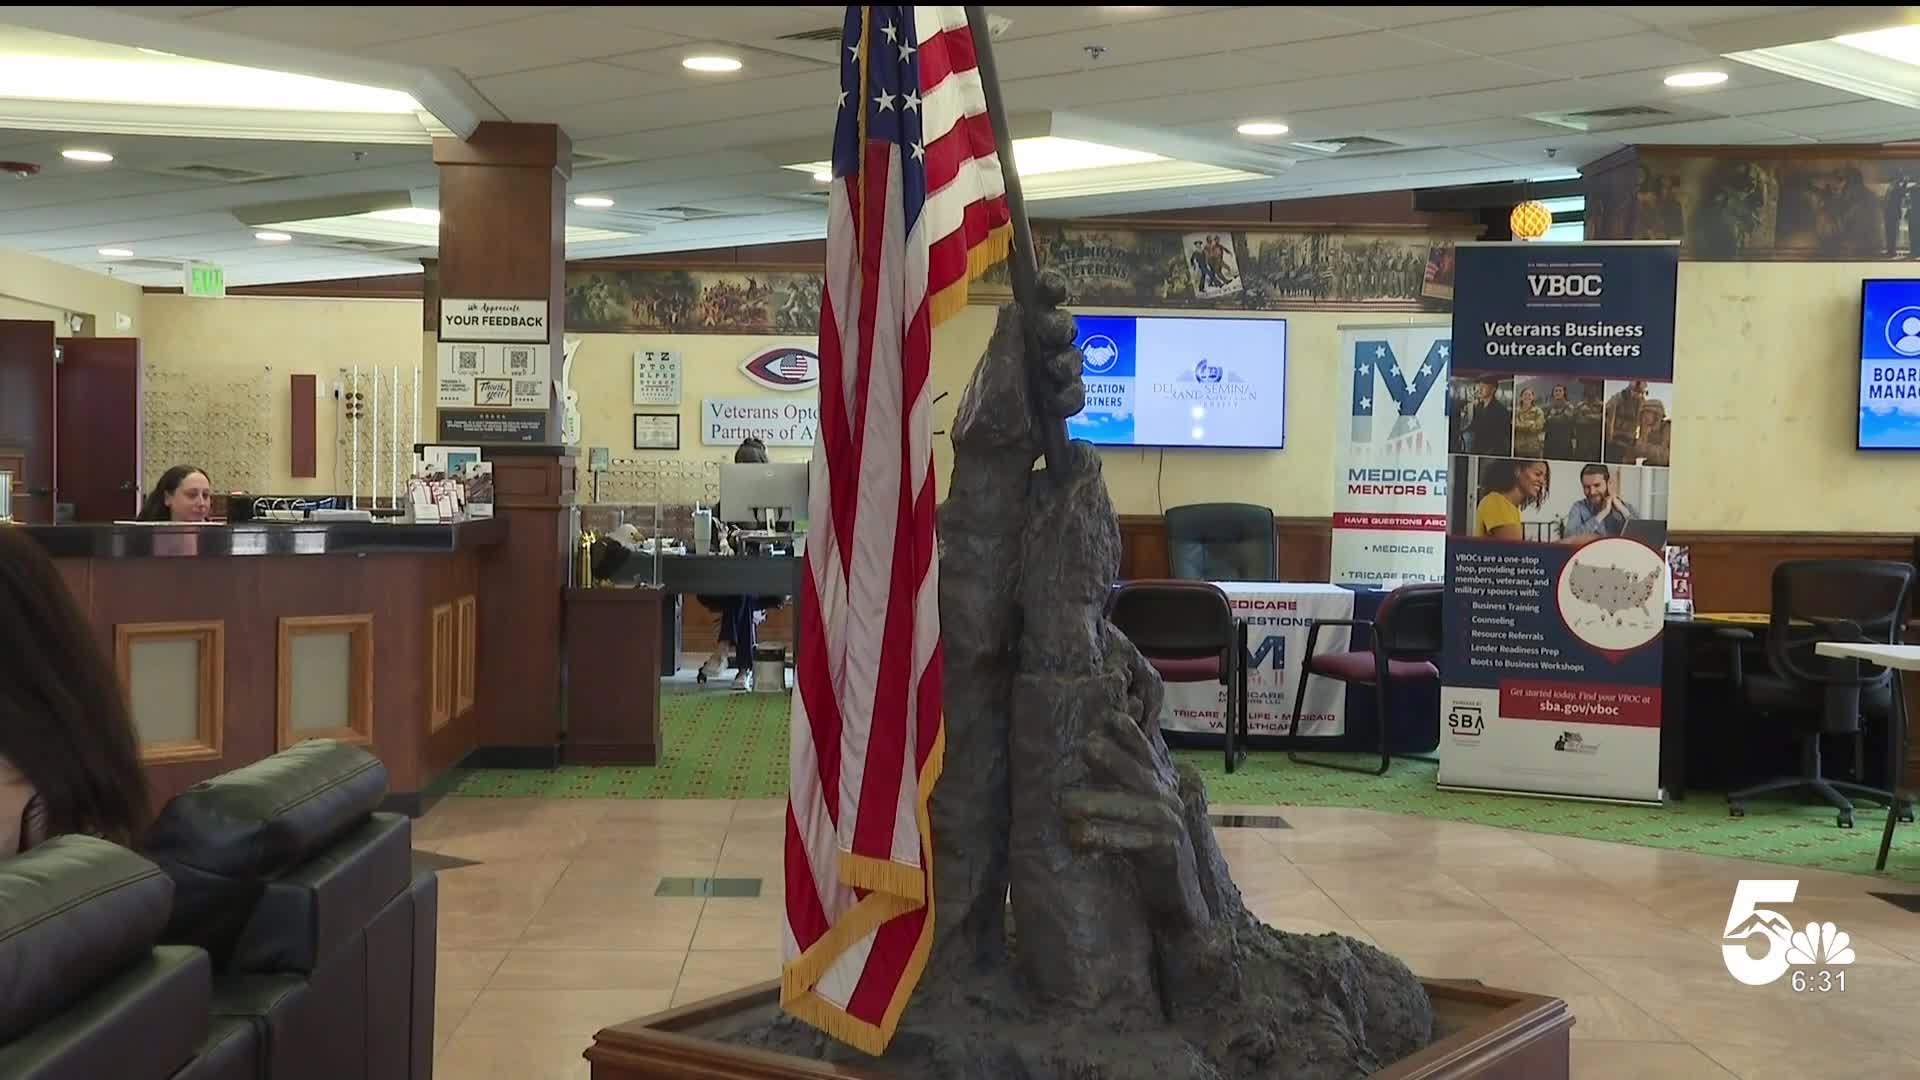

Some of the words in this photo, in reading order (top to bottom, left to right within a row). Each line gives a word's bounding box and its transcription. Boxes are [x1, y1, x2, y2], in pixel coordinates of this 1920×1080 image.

[1527, 274, 1602, 297] VBOC
[446, 315, 479, 326] YOUR
[482, 316, 543, 327] FEEDBACK
[1485, 322, 1561, 337] Veterans
[1565, 322, 1643, 337] Business
[1487, 341, 1566, 356] Outreach
[1571, 342, 1641, 357] Centers
[1874, 367, 1920, 382] BOAR
[1869, 385, 1920, 399] MANA
[711, 403, 779, 419] Veterans
[712, 424, 774, 439] Partners
[779, 425, 797, 440] of
[1348, 484, 1426, 495] MENTORS
[1344, 516, 1369, 525] HAVE
[1371, 517, 1423, 526] QUESTIONS
[1372, 544, 1434, 554] MEDICARE
[1456, 554, 1481, 562] VBOCs
[1504, 556, 1539, 565] one-stop
[1349, 571, 1397, 580] TRICARE
[1456, 565, 1477, 574] shop,
[1478, 565, 1515, 576] providing
[1517, 567, 1545, 575] service
[1455, 576, 1494, 585] members,
[1496, 577, 1532, 587] veterans,
[1534, 578, 1549, 586] and
[1455, 586, 1485, 596] military
[1487, 588, 1518, 596] spouses
[1472, 601, 1506, 611] Business
[1508, 602, 1540, 614] Training
[1471, 615, 1515, 627] Counseling
[1471, 629, 1507, 639] Resource
[1509, 631, 1544, 641] Referrals
[1471, 643, 1499, 653] Lender
[1500, 645, 1539, 655] Readiness
[1540, 647, 1560, 657] Prep
[1470, 658, 1493, 667] Boots
[1495, 659, 1503, 667] to
[1505, 660, 1539, 669] Business
[1540, 662, 1584, 672] Workshops
[1510, 688, 1524, 697] Get
[1525, 688, 1552, 698] started
[1553, 690, 1576, 700] today.
[1578, 691, 1597, 701] Find
[1598, 694, 1616, 703] your
[1618, 694, 1641, 704] VBOC
[1174, 710, 1219, 719] TRICARE
[1540, 700, 1619, 716] sba.gov/vboc
[1448, 713, 1484, 729] SBA
